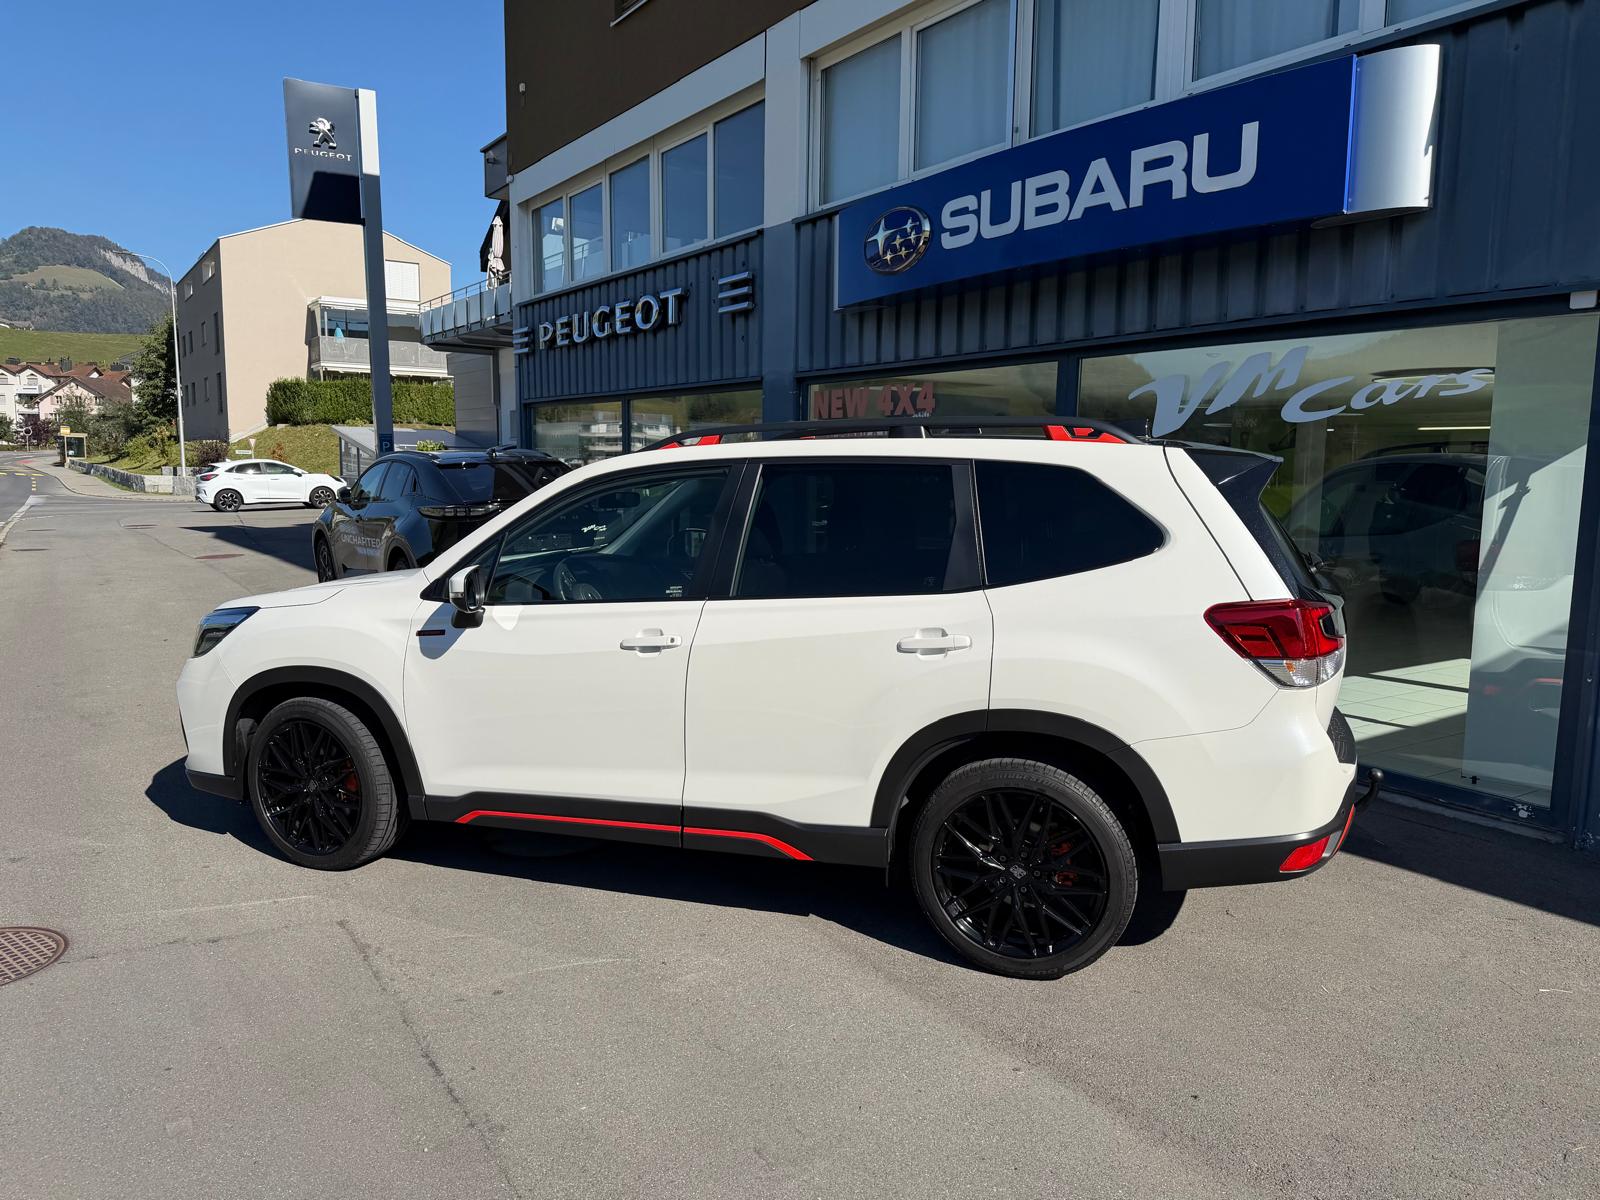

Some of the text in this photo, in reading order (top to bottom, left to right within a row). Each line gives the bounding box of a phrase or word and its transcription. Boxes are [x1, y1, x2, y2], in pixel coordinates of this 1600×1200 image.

[293, 147, 353, 161] PEUGEOT
[940, 121, 1260, 250] SUBARU
[538, 287, 682, 350] PEUGEOT
[813, 382, 936, 419] NEW 4X4
[1281, 367, 1495, 423] Cars
[341, 533, 381, 548] UNCHARTED
